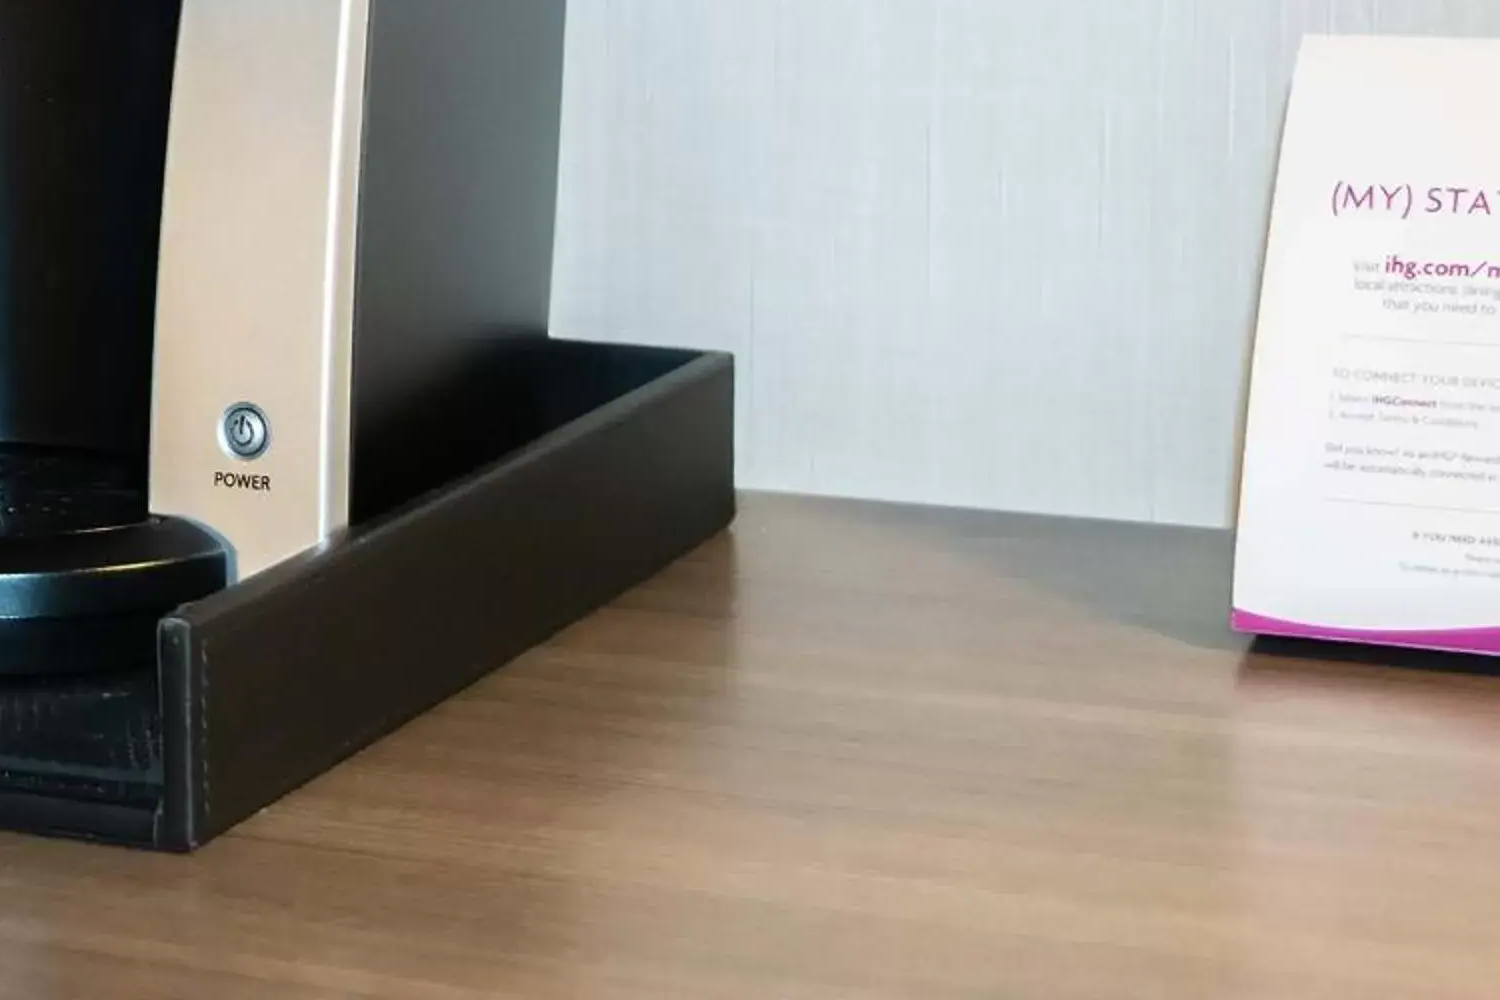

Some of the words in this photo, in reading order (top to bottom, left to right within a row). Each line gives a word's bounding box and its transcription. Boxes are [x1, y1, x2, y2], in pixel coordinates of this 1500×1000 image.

[1331, 180, 1413, 220] (MY)
[1425, 187, 1500, 216] STA
[213, 471, 271, 491] POWER
